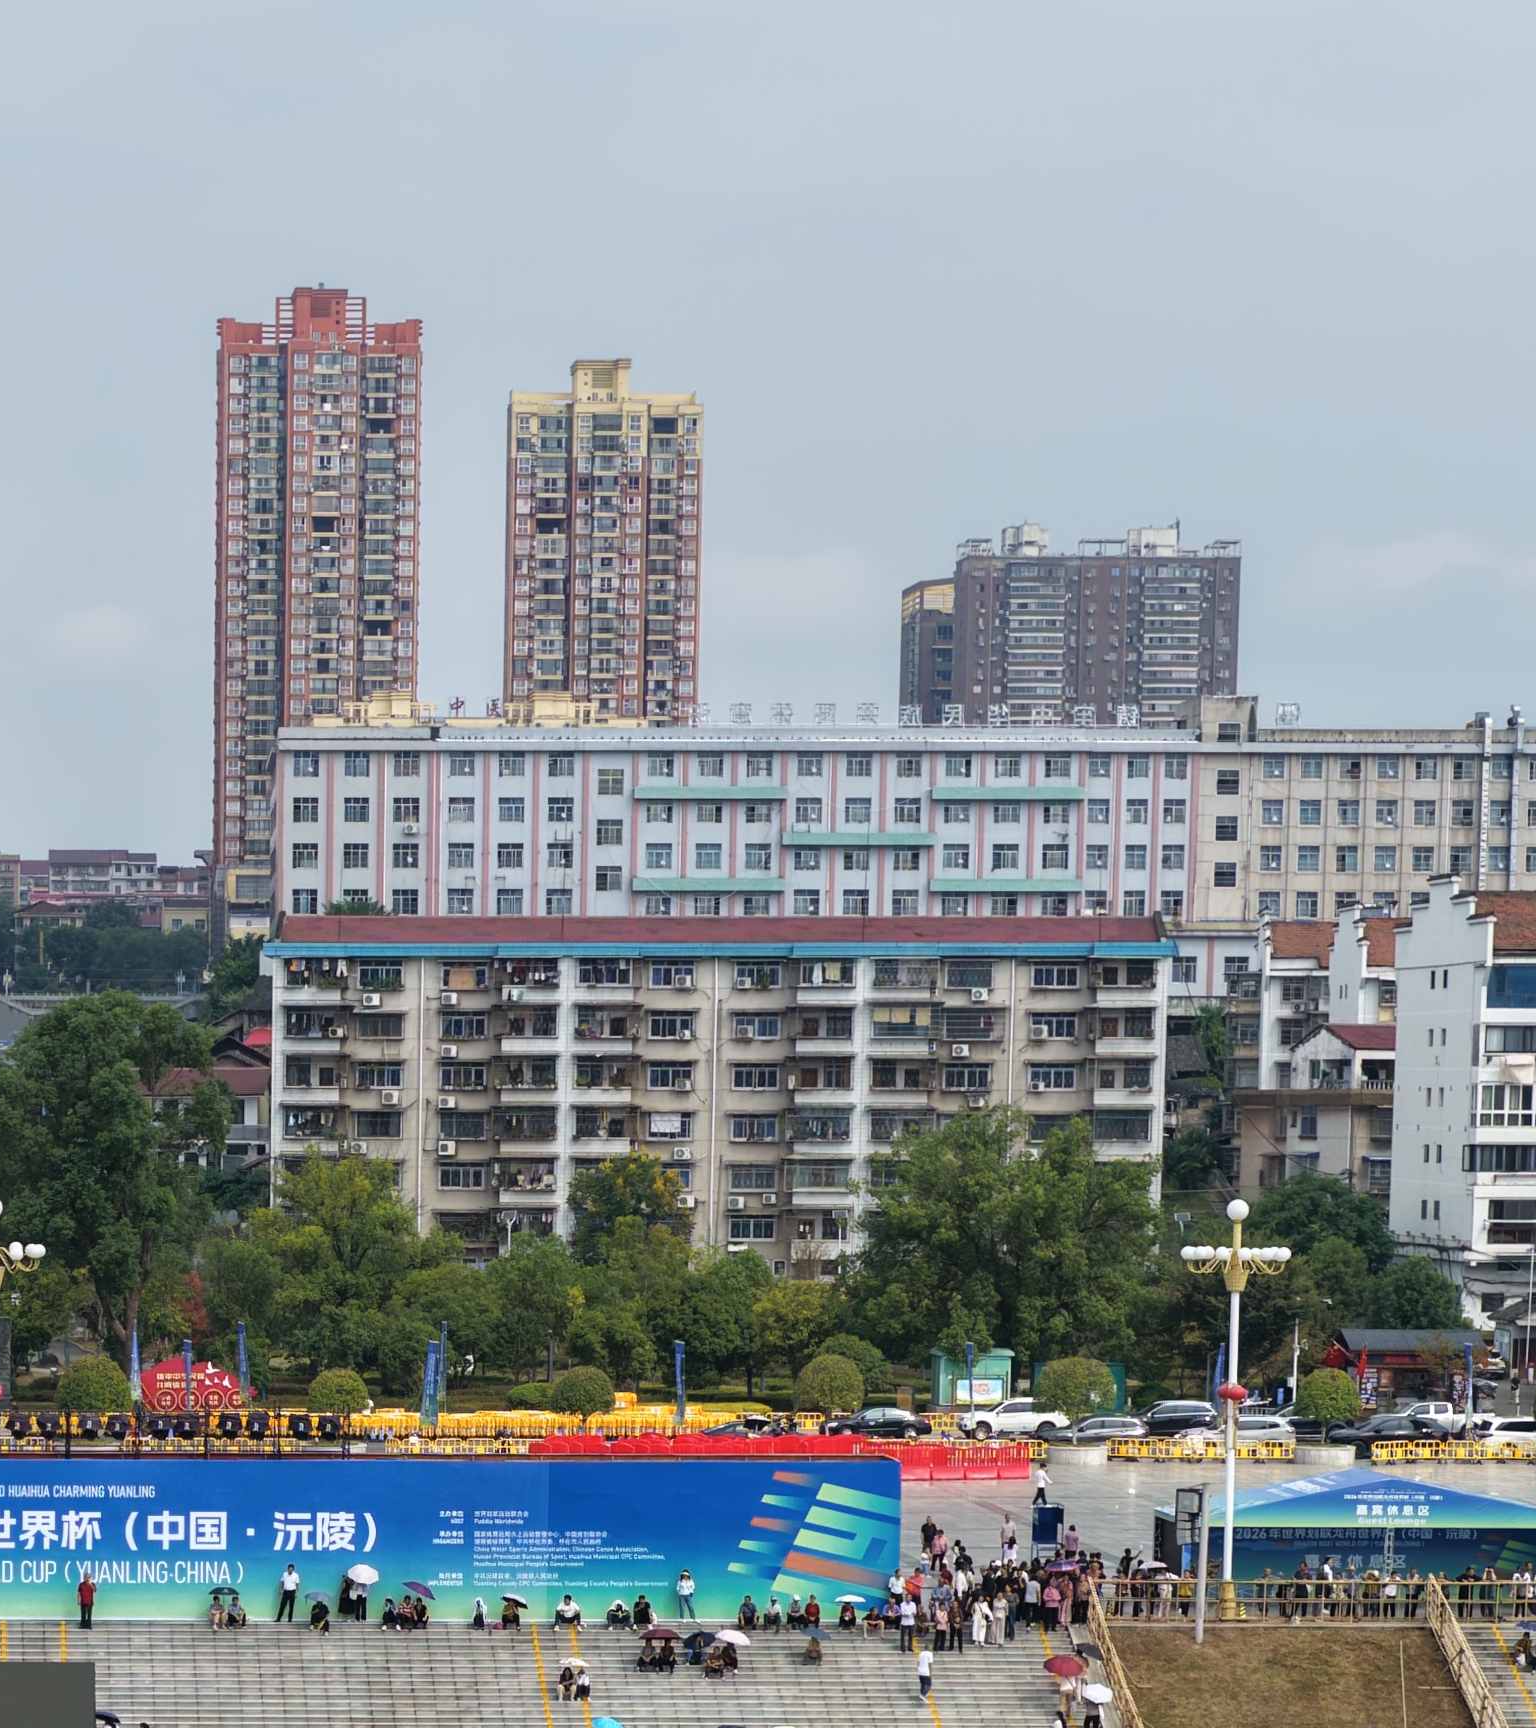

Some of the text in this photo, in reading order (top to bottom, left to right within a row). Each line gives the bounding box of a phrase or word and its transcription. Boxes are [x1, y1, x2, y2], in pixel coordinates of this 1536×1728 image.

[8, 1484, 50, 1498] HUAIHUA
[53, 1484, 104, 1498] CHARMING
[108, 1484, 155, 1498] YUANLING
[1356, 1504, 1430, 1516] 嘉宾休息区
[21, 1560, 57, 1583] CUP
